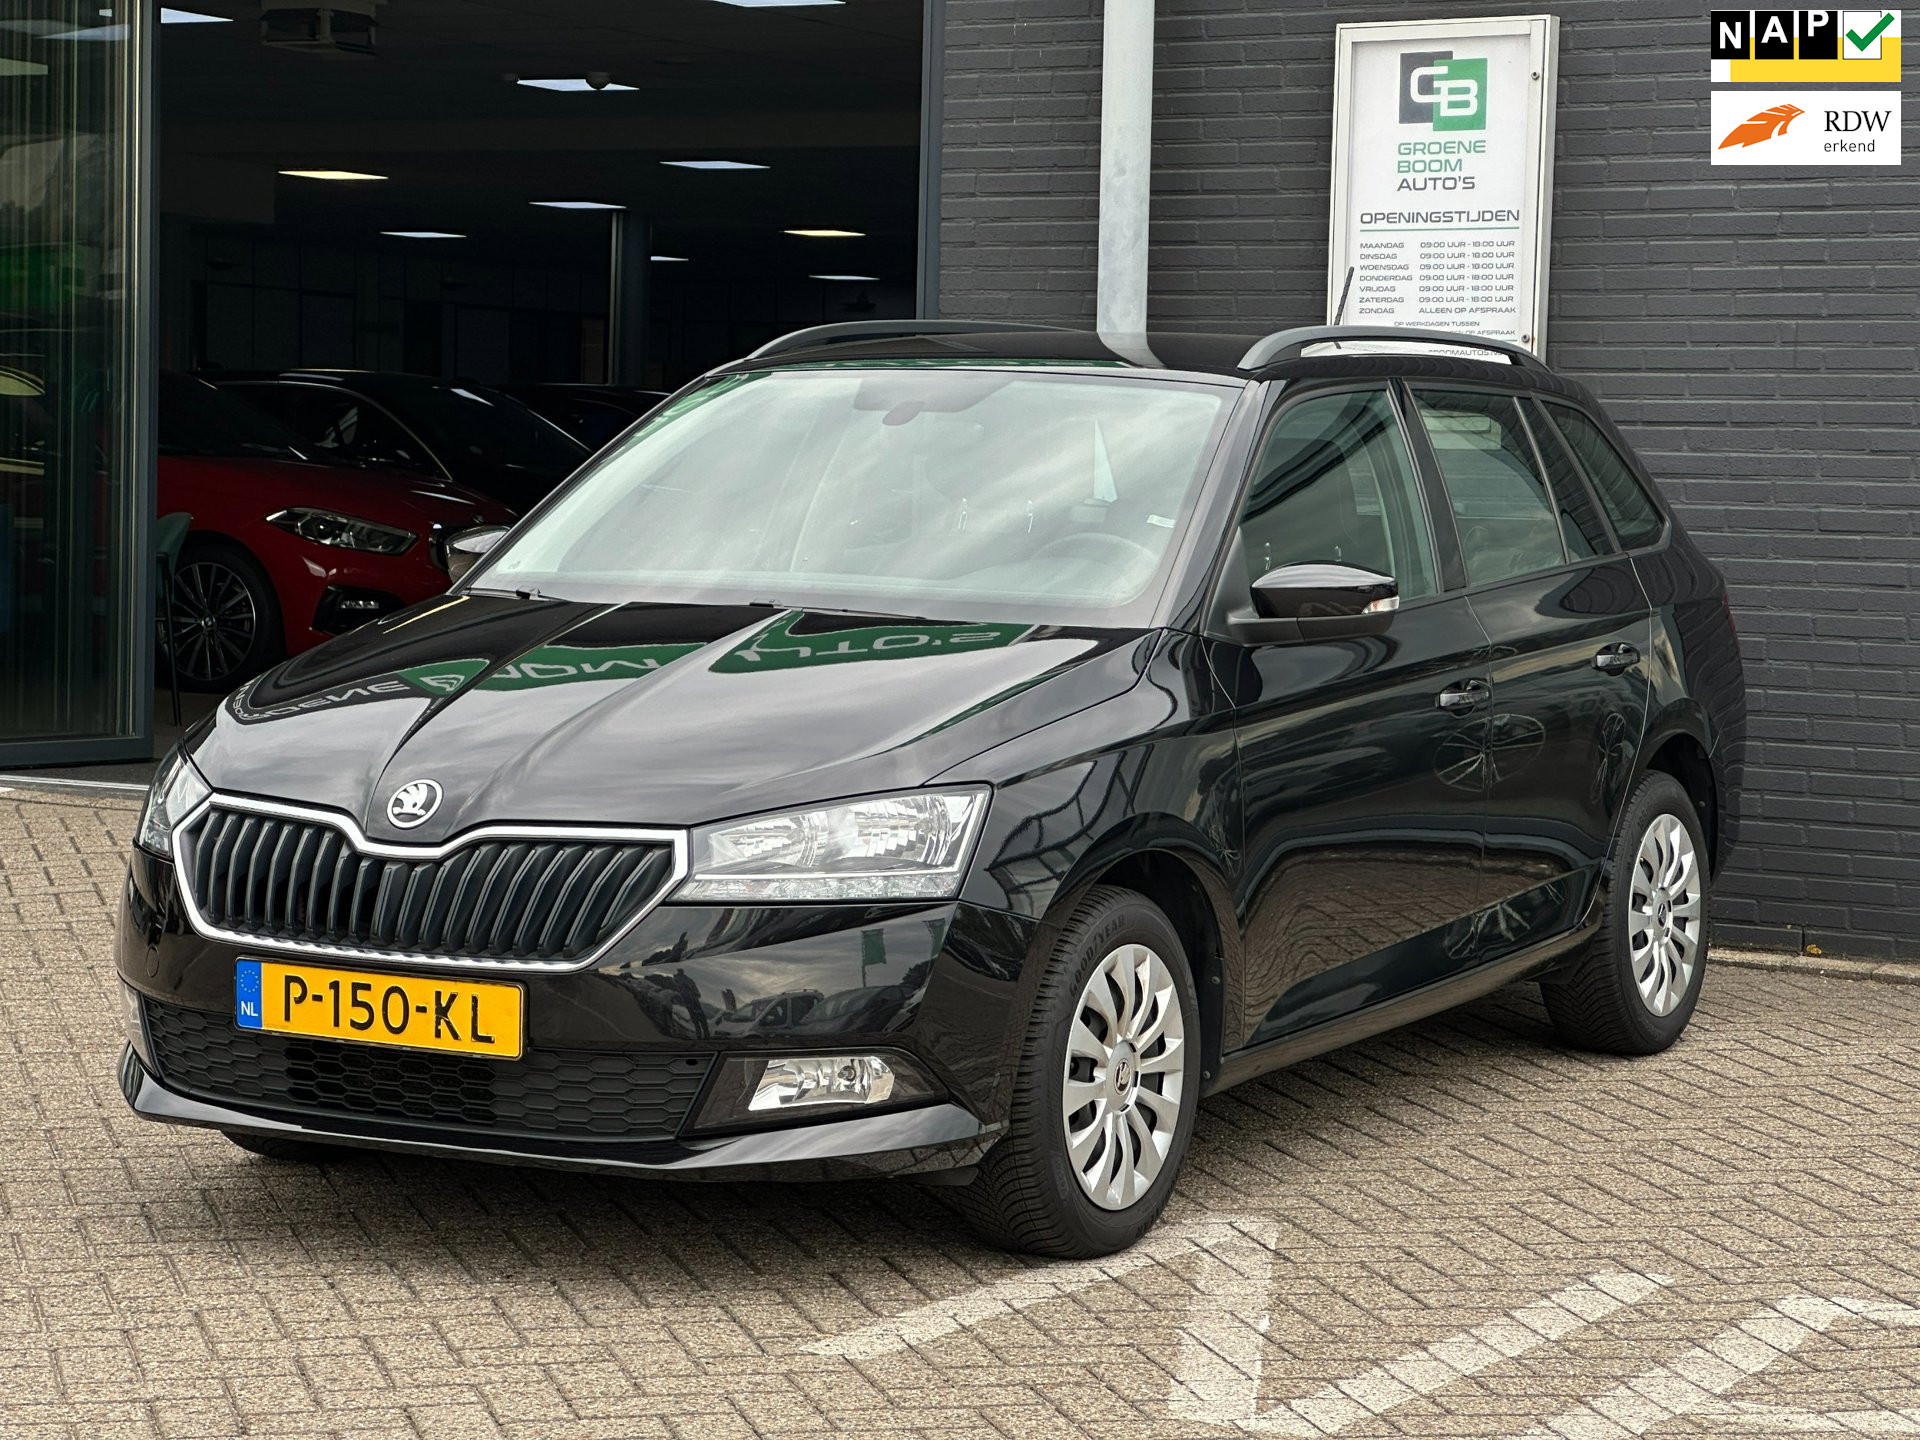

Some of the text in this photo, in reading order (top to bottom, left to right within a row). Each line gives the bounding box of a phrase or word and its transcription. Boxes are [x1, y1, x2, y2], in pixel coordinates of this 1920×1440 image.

[1398, 140, 1486, 155] GROENE
[1397, 159, 1462, 173] BOOM
[1397, 176, 1475, 191] AUTO'S
[1360, 209, 1519, 224] OPENINGSTIJDEN
[241, 1001, 258, 1016] NL
[284, 974, 495, 1044] P-150-KL
